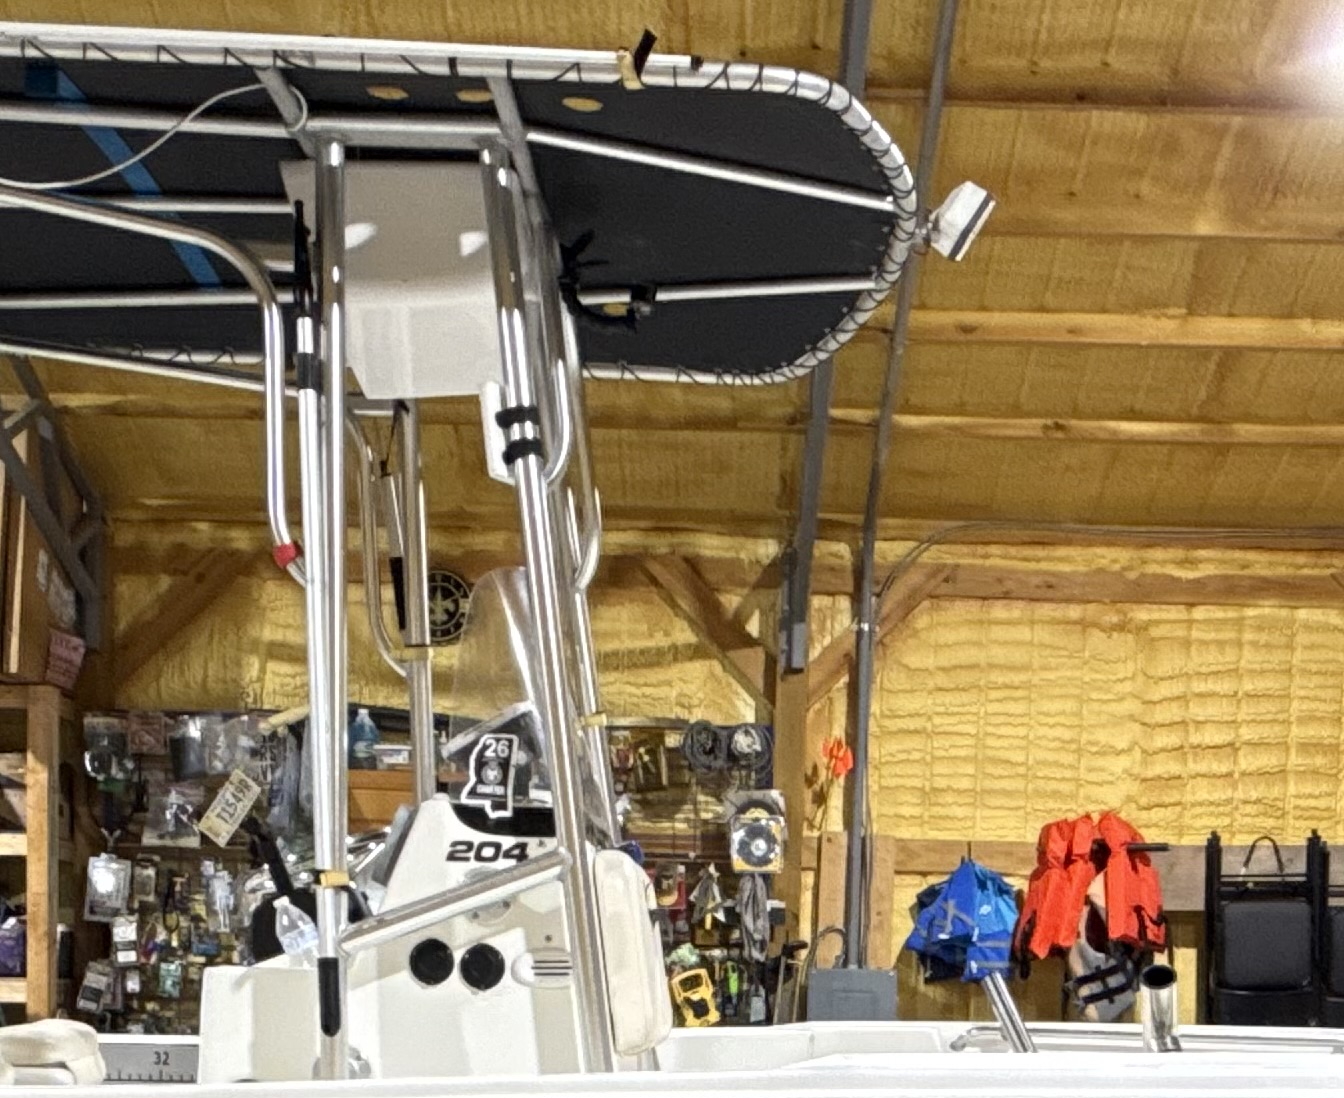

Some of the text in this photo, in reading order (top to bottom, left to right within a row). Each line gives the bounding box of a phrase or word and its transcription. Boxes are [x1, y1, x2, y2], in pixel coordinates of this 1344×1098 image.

[484, 739, 510, 758] 26
[445, 840, 530, 863] 204
[153, 1051, 171, 1066] 32
